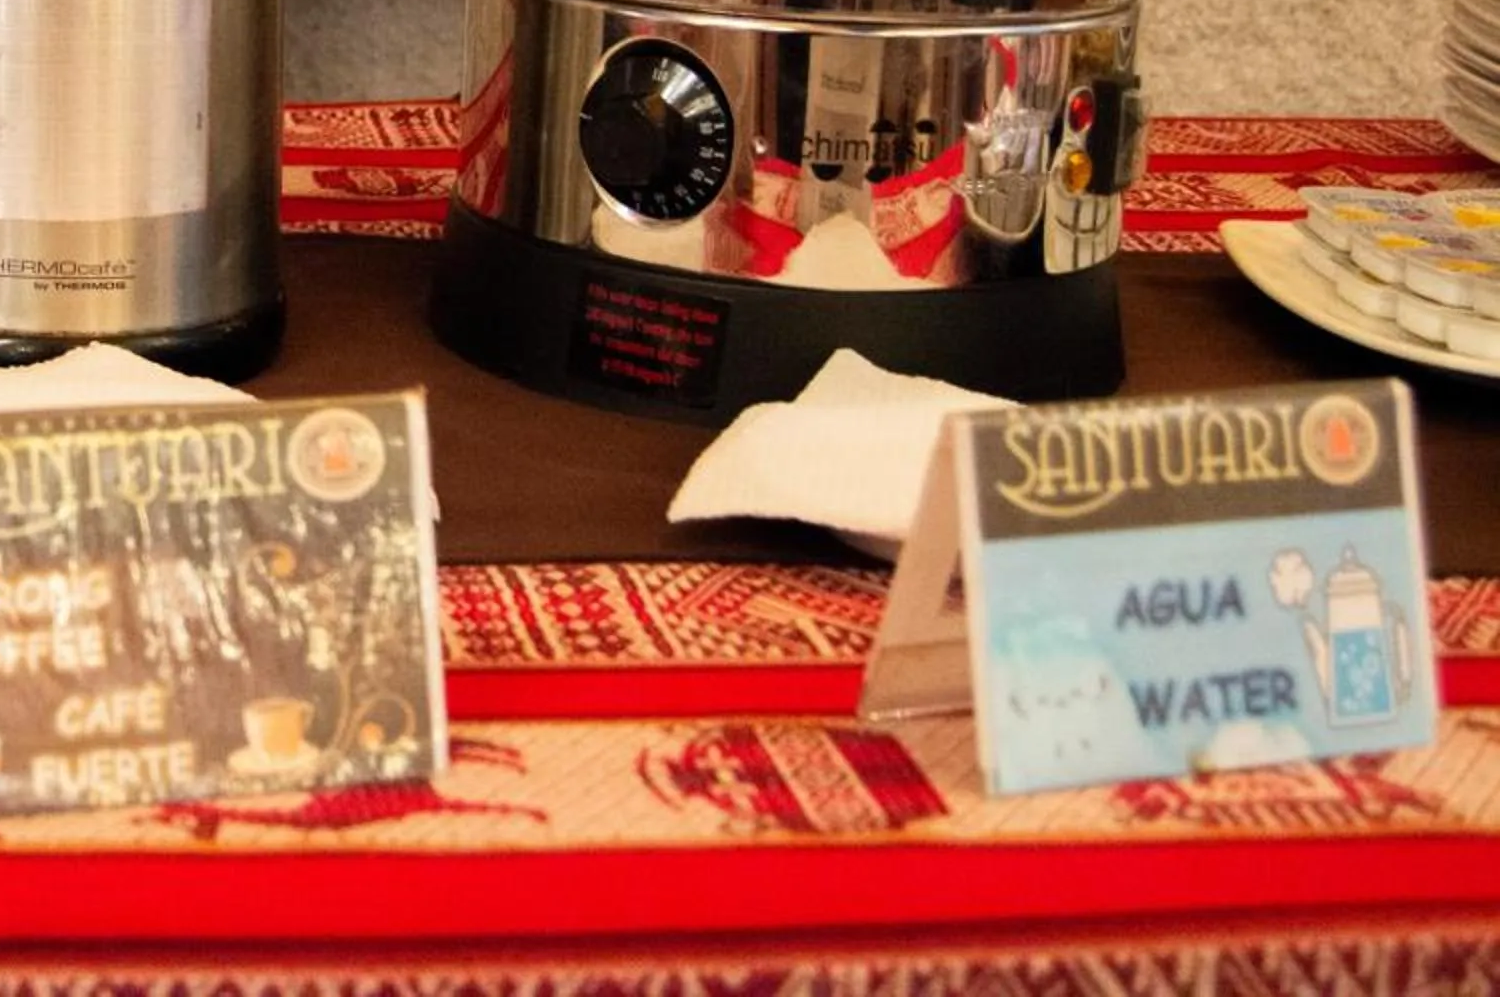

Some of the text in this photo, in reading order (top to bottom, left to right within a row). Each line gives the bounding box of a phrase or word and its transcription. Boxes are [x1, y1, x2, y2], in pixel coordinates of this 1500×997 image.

[53, 281, 126, 291] THERMOS
[1115, 576, 1246, 630] AGUA
[1129, 667, 1300, 729] WATER
[29, 741, 196, 803] FUERTE
